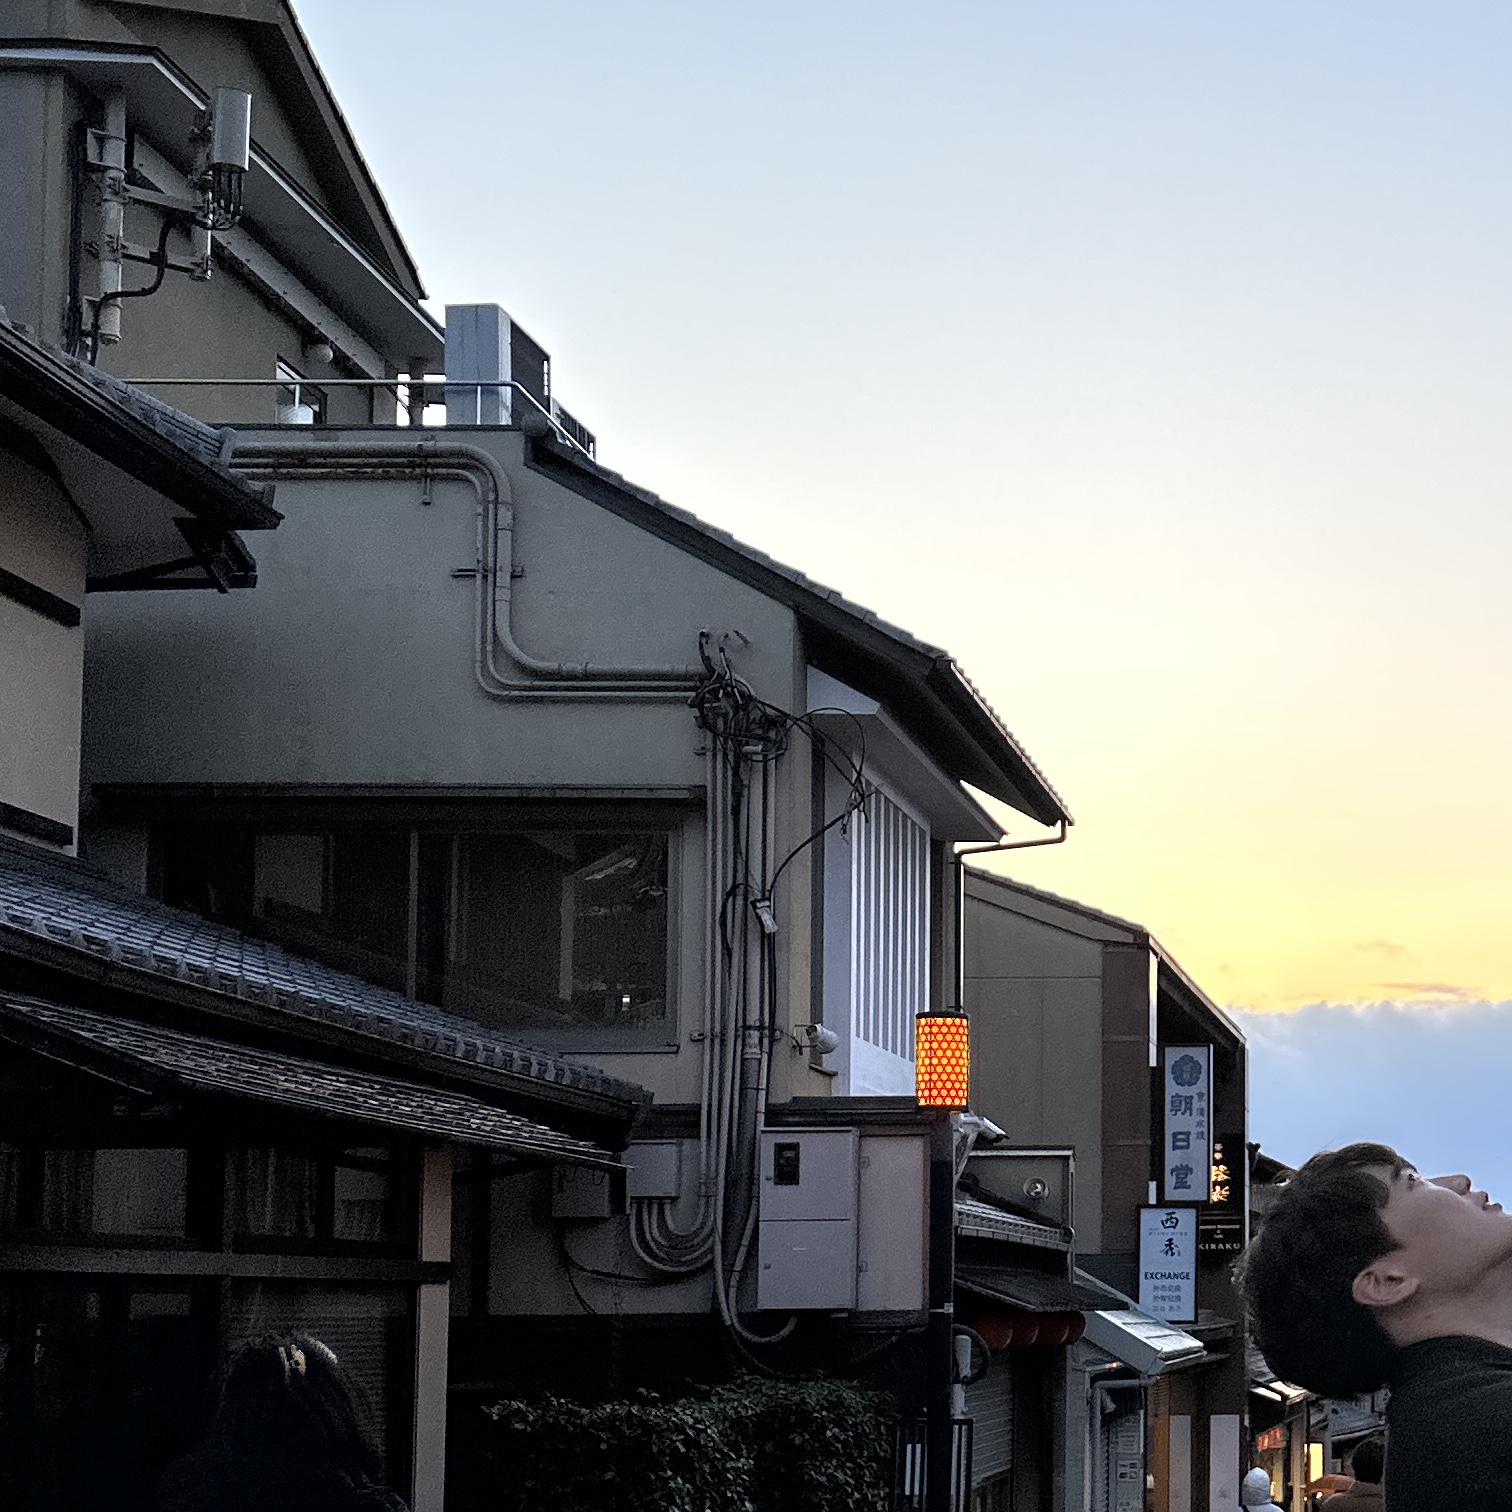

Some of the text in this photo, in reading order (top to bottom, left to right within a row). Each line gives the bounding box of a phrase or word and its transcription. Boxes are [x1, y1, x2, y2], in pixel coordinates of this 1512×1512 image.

[1169, 1092, 1194, 1191] 朝日堂
[1160, 1211, 1181, 1257] 西秀
[1144, 1271, 1191, 1280] EXCHANGE
